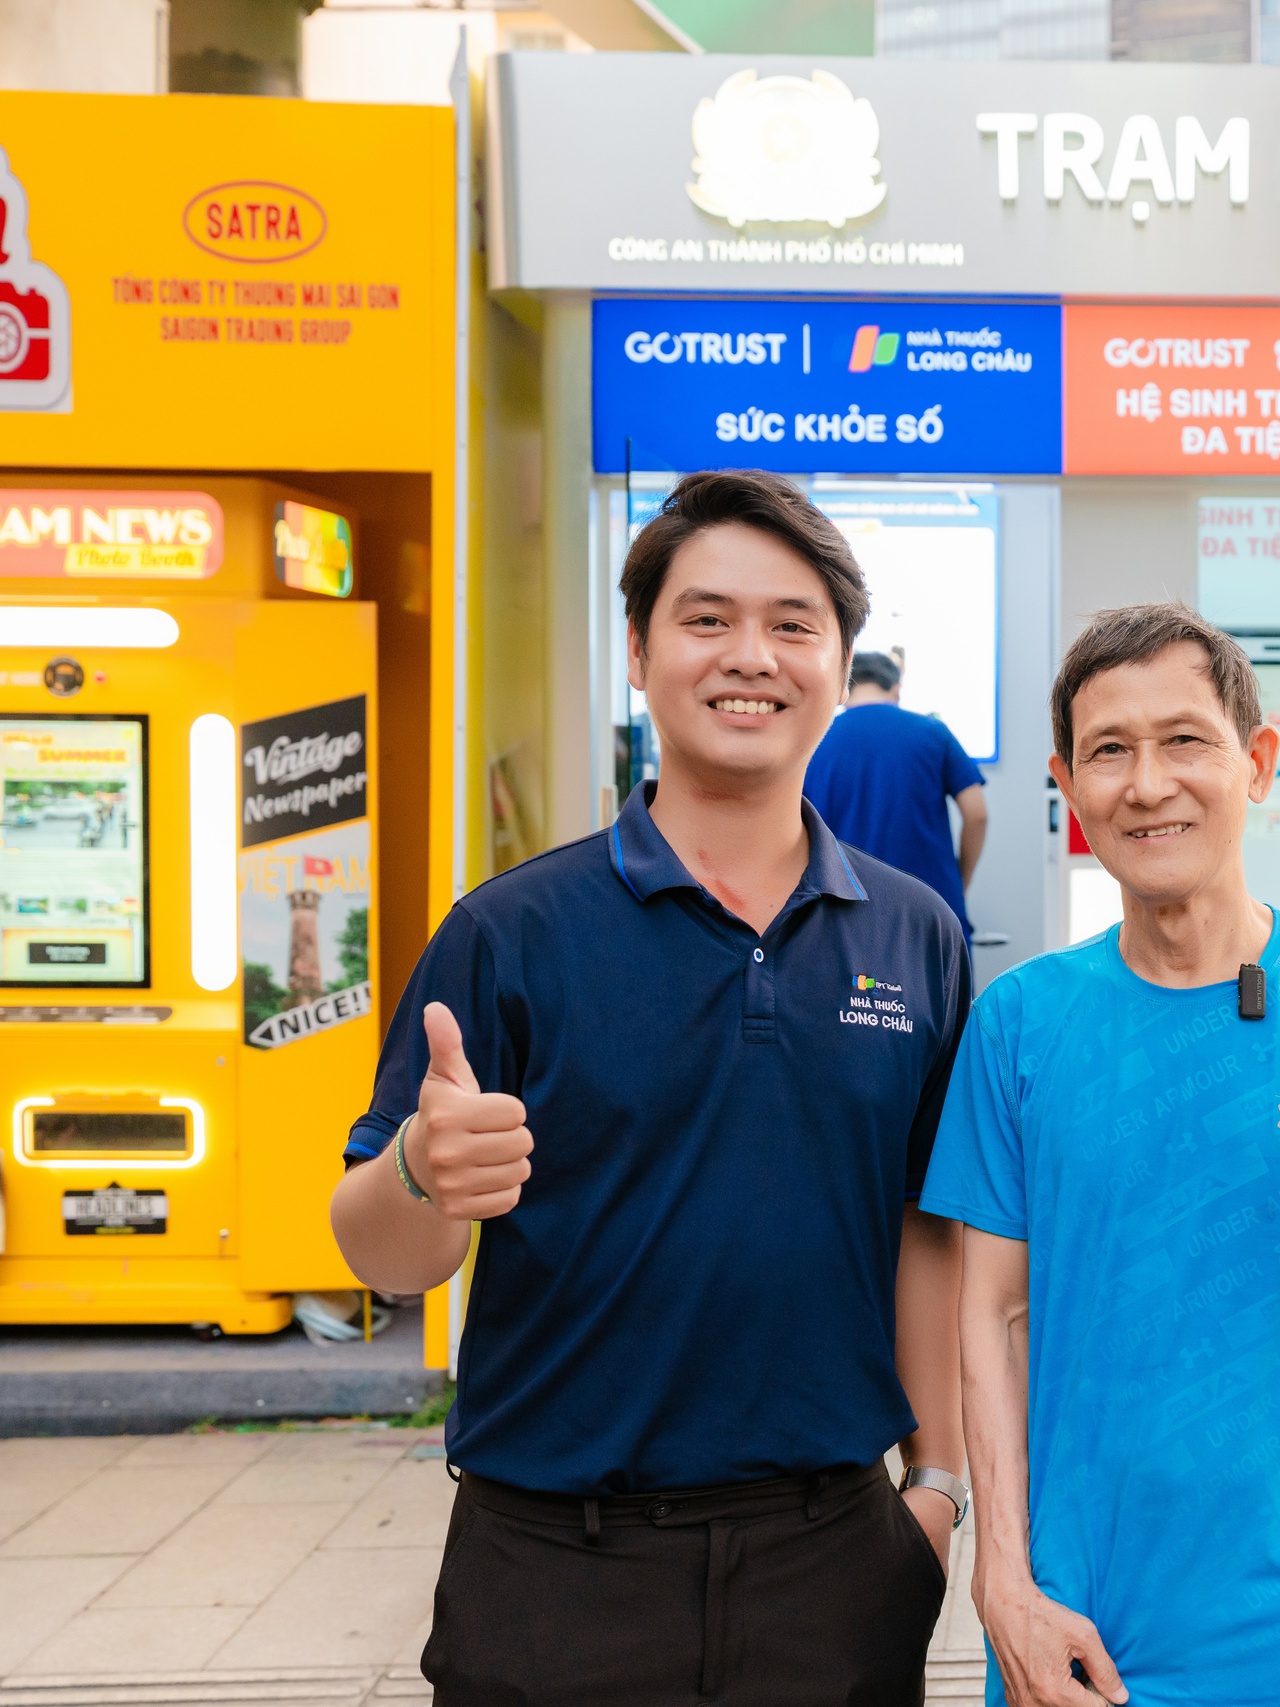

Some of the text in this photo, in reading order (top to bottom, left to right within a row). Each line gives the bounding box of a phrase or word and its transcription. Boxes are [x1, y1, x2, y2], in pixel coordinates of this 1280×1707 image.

[976, 112, 1250, 222] TRẠM
[206, 202, 302, 242] SATRA
[608, 236, 668, 261] CÔNG
[671, 239, 704, 261] AN
[908, 242, 964, 266] MINH
[208, 279, 227, 306] TY
[160, 316, 352, 345] SAIGON TRADING GROUP
[624, 330, 787, 365] GOTRUST
[907, 328, 942, 347] NHÀ
[907, 348, 1033, 372] LONG CHÂU
[1103, 337, 1250, 368] GOTRUST
[1116, 382, 1162, 422] HỆ
[1170, 388, 1247, 418] SINH
[716, 403, 944, 443] SỨC KHỎE SỐ
[1181, 426, 1228, 455] ĐA
[81, 506, 213, 547] NEWS
[39, 748, 127, 763] SUMMER
[244, 730, 364, 786] Vintage
[243, 771, 370, 826] Newspaper
[839, 1010, 913, 1033] LONG CHÂU
[850, 996, 905, 1013] NHÀ THUỐC
[1164, 1004, 1237, 1055] UNDER
[1153, 1054, 1243, 1119] ARMOUR
[1187, 1205, 1262, 1258] UNDER
[1173, 1258, 1264, 1322] ARMOUR
[1205, 1392, 1278, 1448] UNDER
